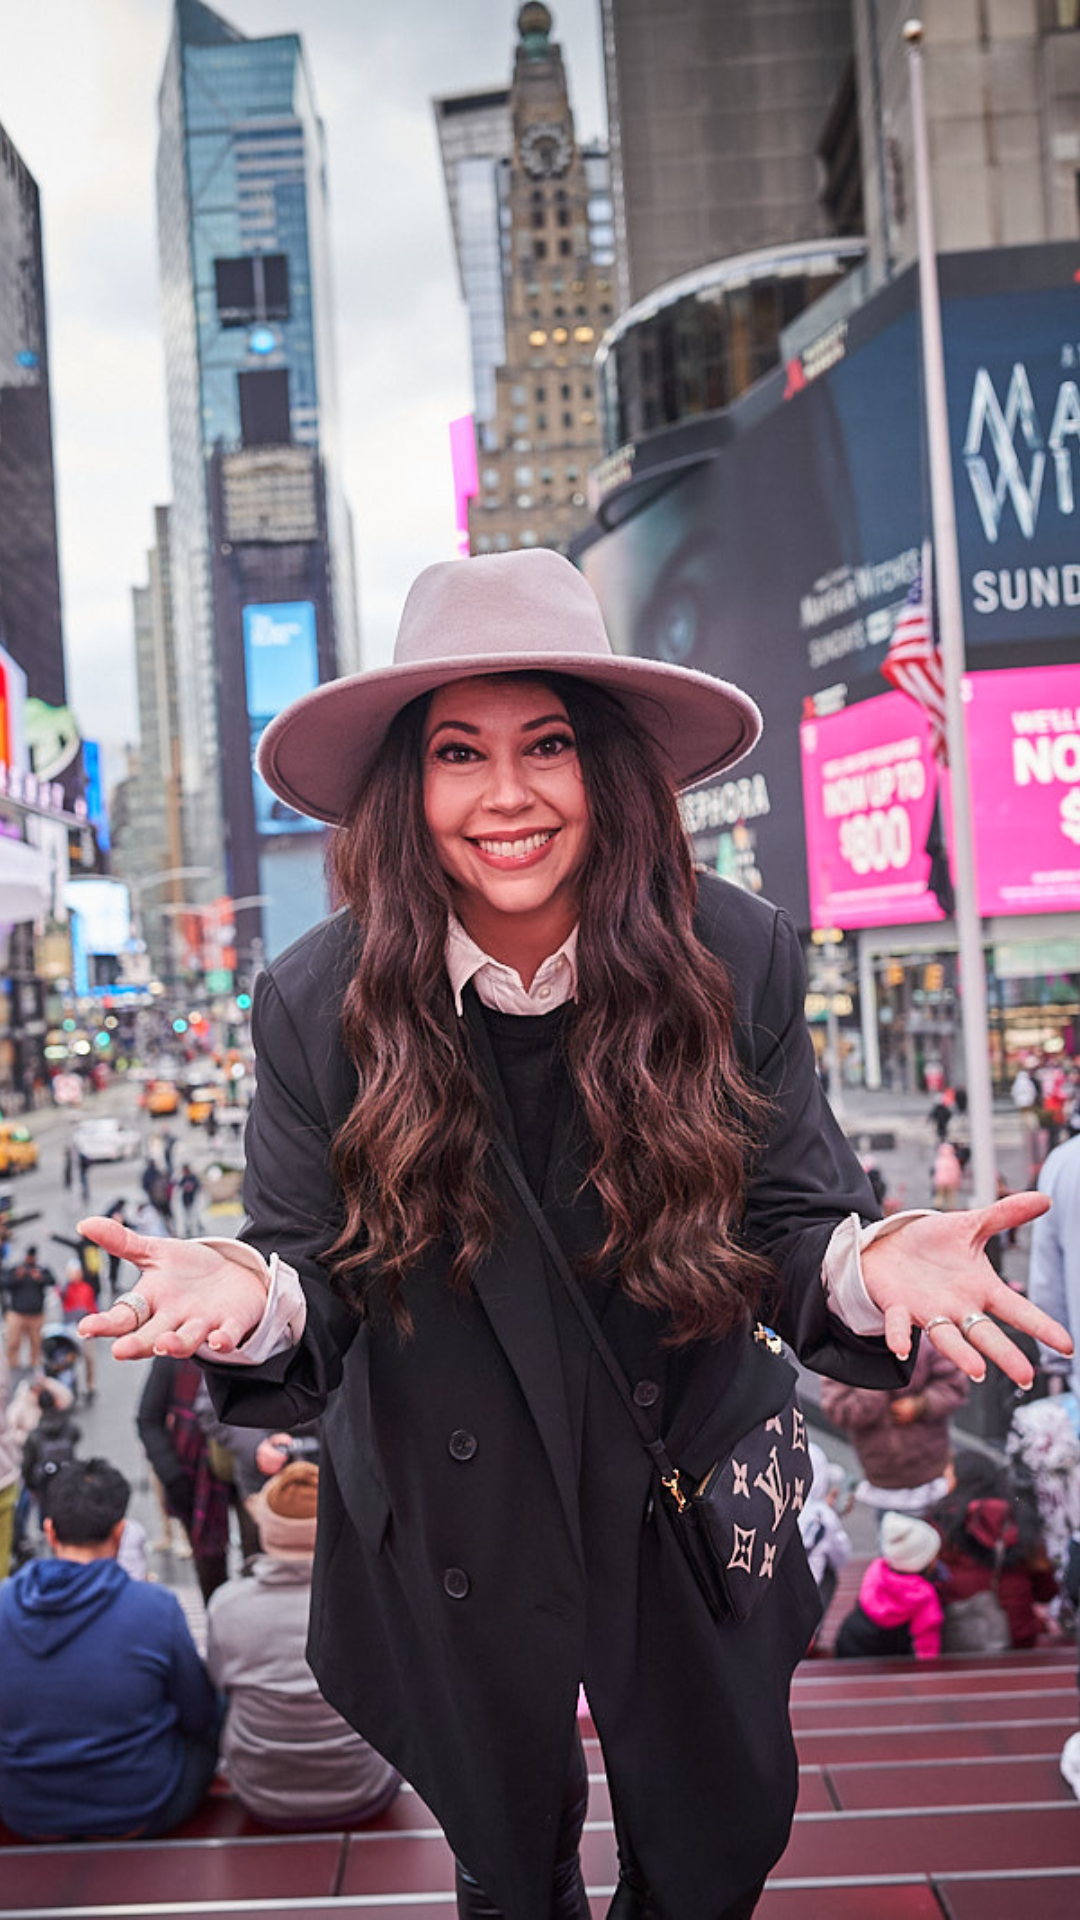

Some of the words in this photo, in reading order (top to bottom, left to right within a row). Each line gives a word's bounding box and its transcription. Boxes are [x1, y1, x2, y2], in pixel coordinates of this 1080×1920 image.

[972, 564, 1080, 614] SUND
[866, 766, 895, 808] UP
[893, 758, 926, 802] TO
[1012, 734, 1080, 786] NO
[678, 774, 770, 833] EPHORA
